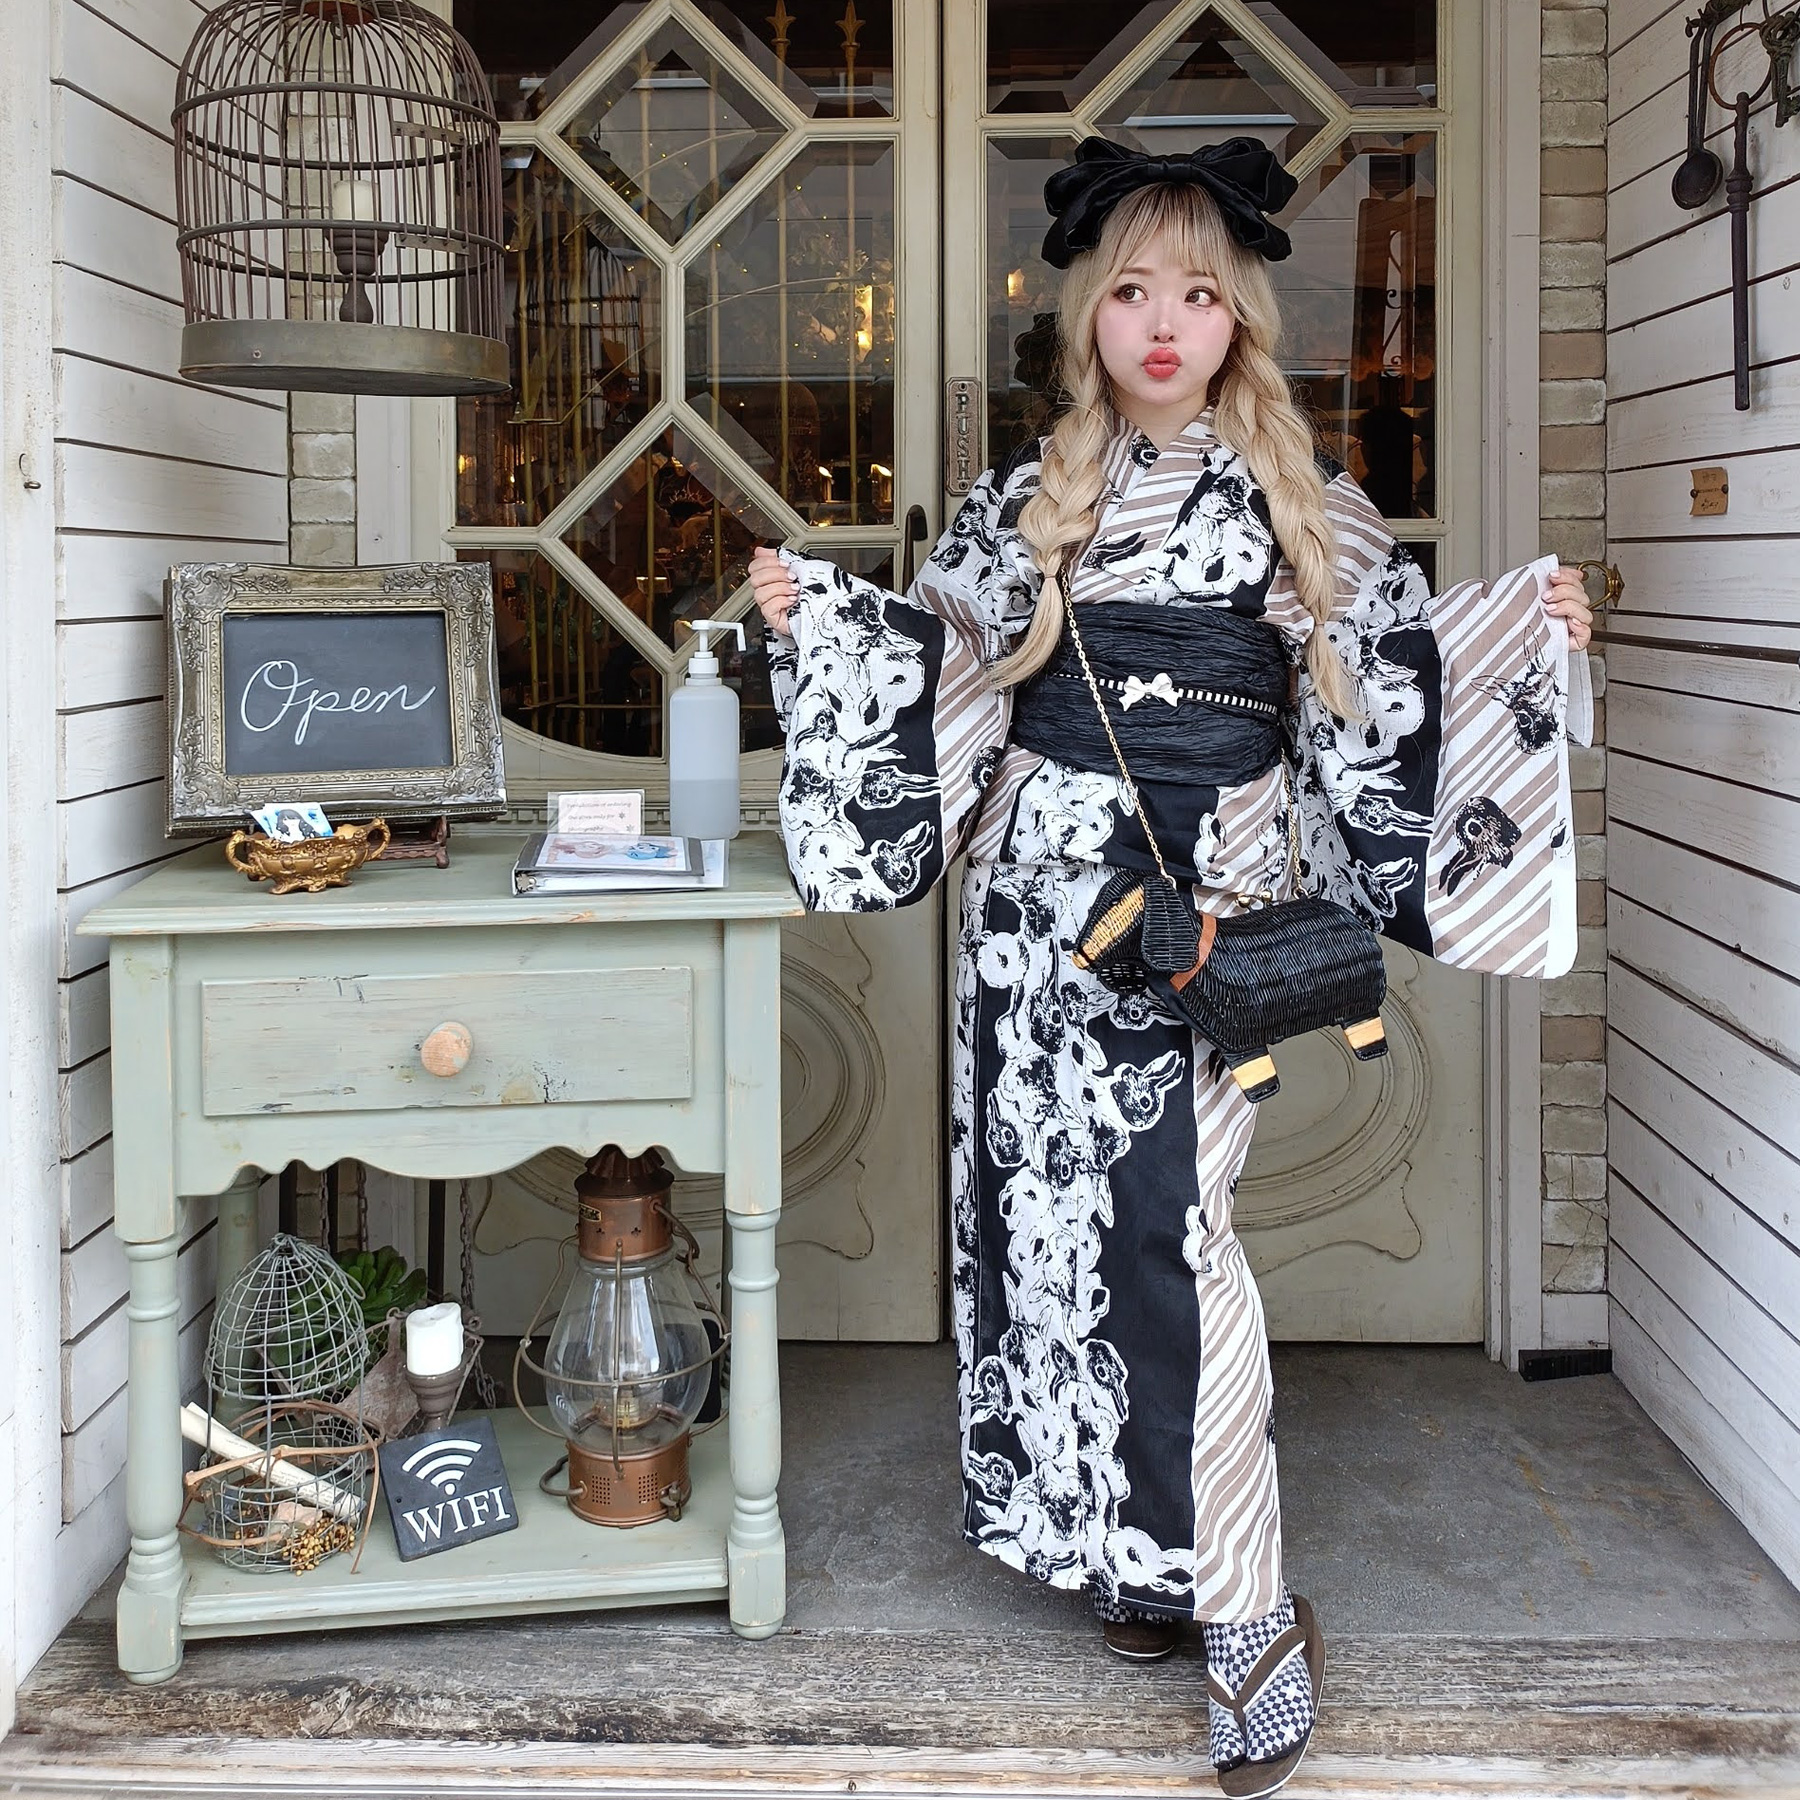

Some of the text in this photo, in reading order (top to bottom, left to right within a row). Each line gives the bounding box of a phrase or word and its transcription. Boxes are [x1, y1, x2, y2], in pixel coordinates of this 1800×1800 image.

[956, 393, 970, 480] PUSH
[240, 659, 436, 745] Open
[402, 1486, 511, 1543] WIFI
